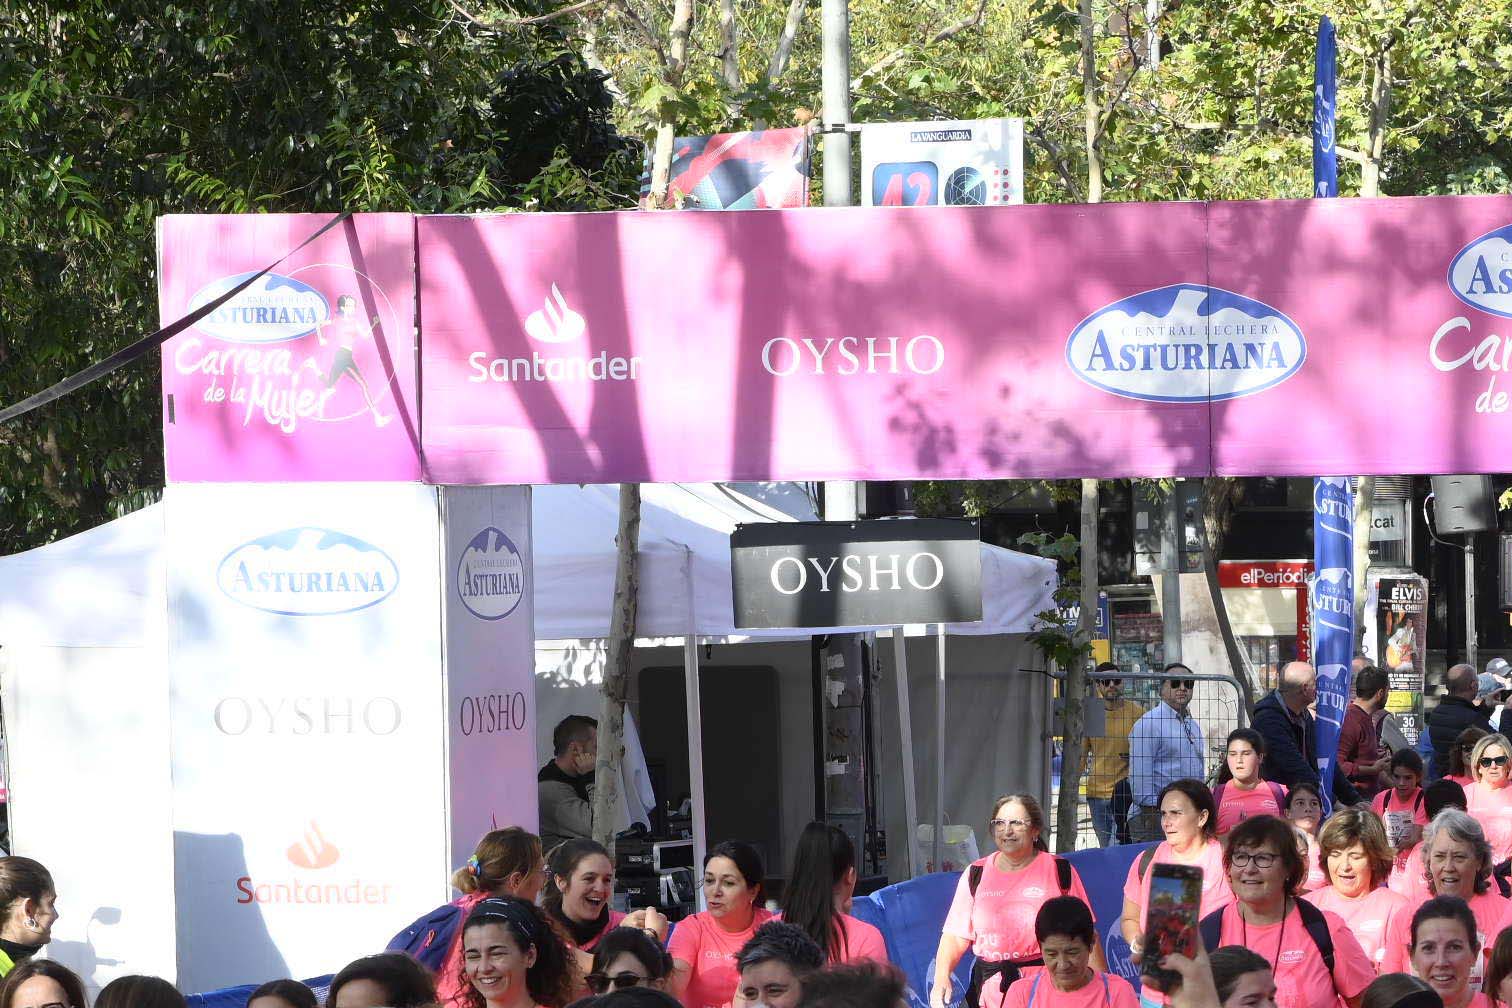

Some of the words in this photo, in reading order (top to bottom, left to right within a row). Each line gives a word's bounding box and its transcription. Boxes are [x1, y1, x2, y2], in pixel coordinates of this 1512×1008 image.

[922, 129, 971, 141] VANGUARDIA
[1120, 323, 1198, 336] CENTRAL
[1206, 322, 1280, 335] LECHERA
[175, 337, 294, 375] Carrera
[468, 349, 641, 383] Santander
[761, 334, 946, 378] OYSHO
[1085, 330, 1289, 372] ASTURIANA
[204, 378, 226, 403] de
[230, 379, 245, 403] la
[243, 371, 337, 434] Mujer
[1474, 375, 1509, 414] de
[1371, 515, 1395, 529] .cat
[232, 560, 385, 593] ASTURIANA
[462, 572, 521, 597] ASTURIANA
[770, 552, 944, 595] OYSHO
[1391, 587, 1423, 600] ELVIS
[213, 696, 403, 736] OYSHO
[460, 691, 526, 737] OYSHO
[1402, 717, 1415, 727] 30
[236, 875, 391, 905] Santander
